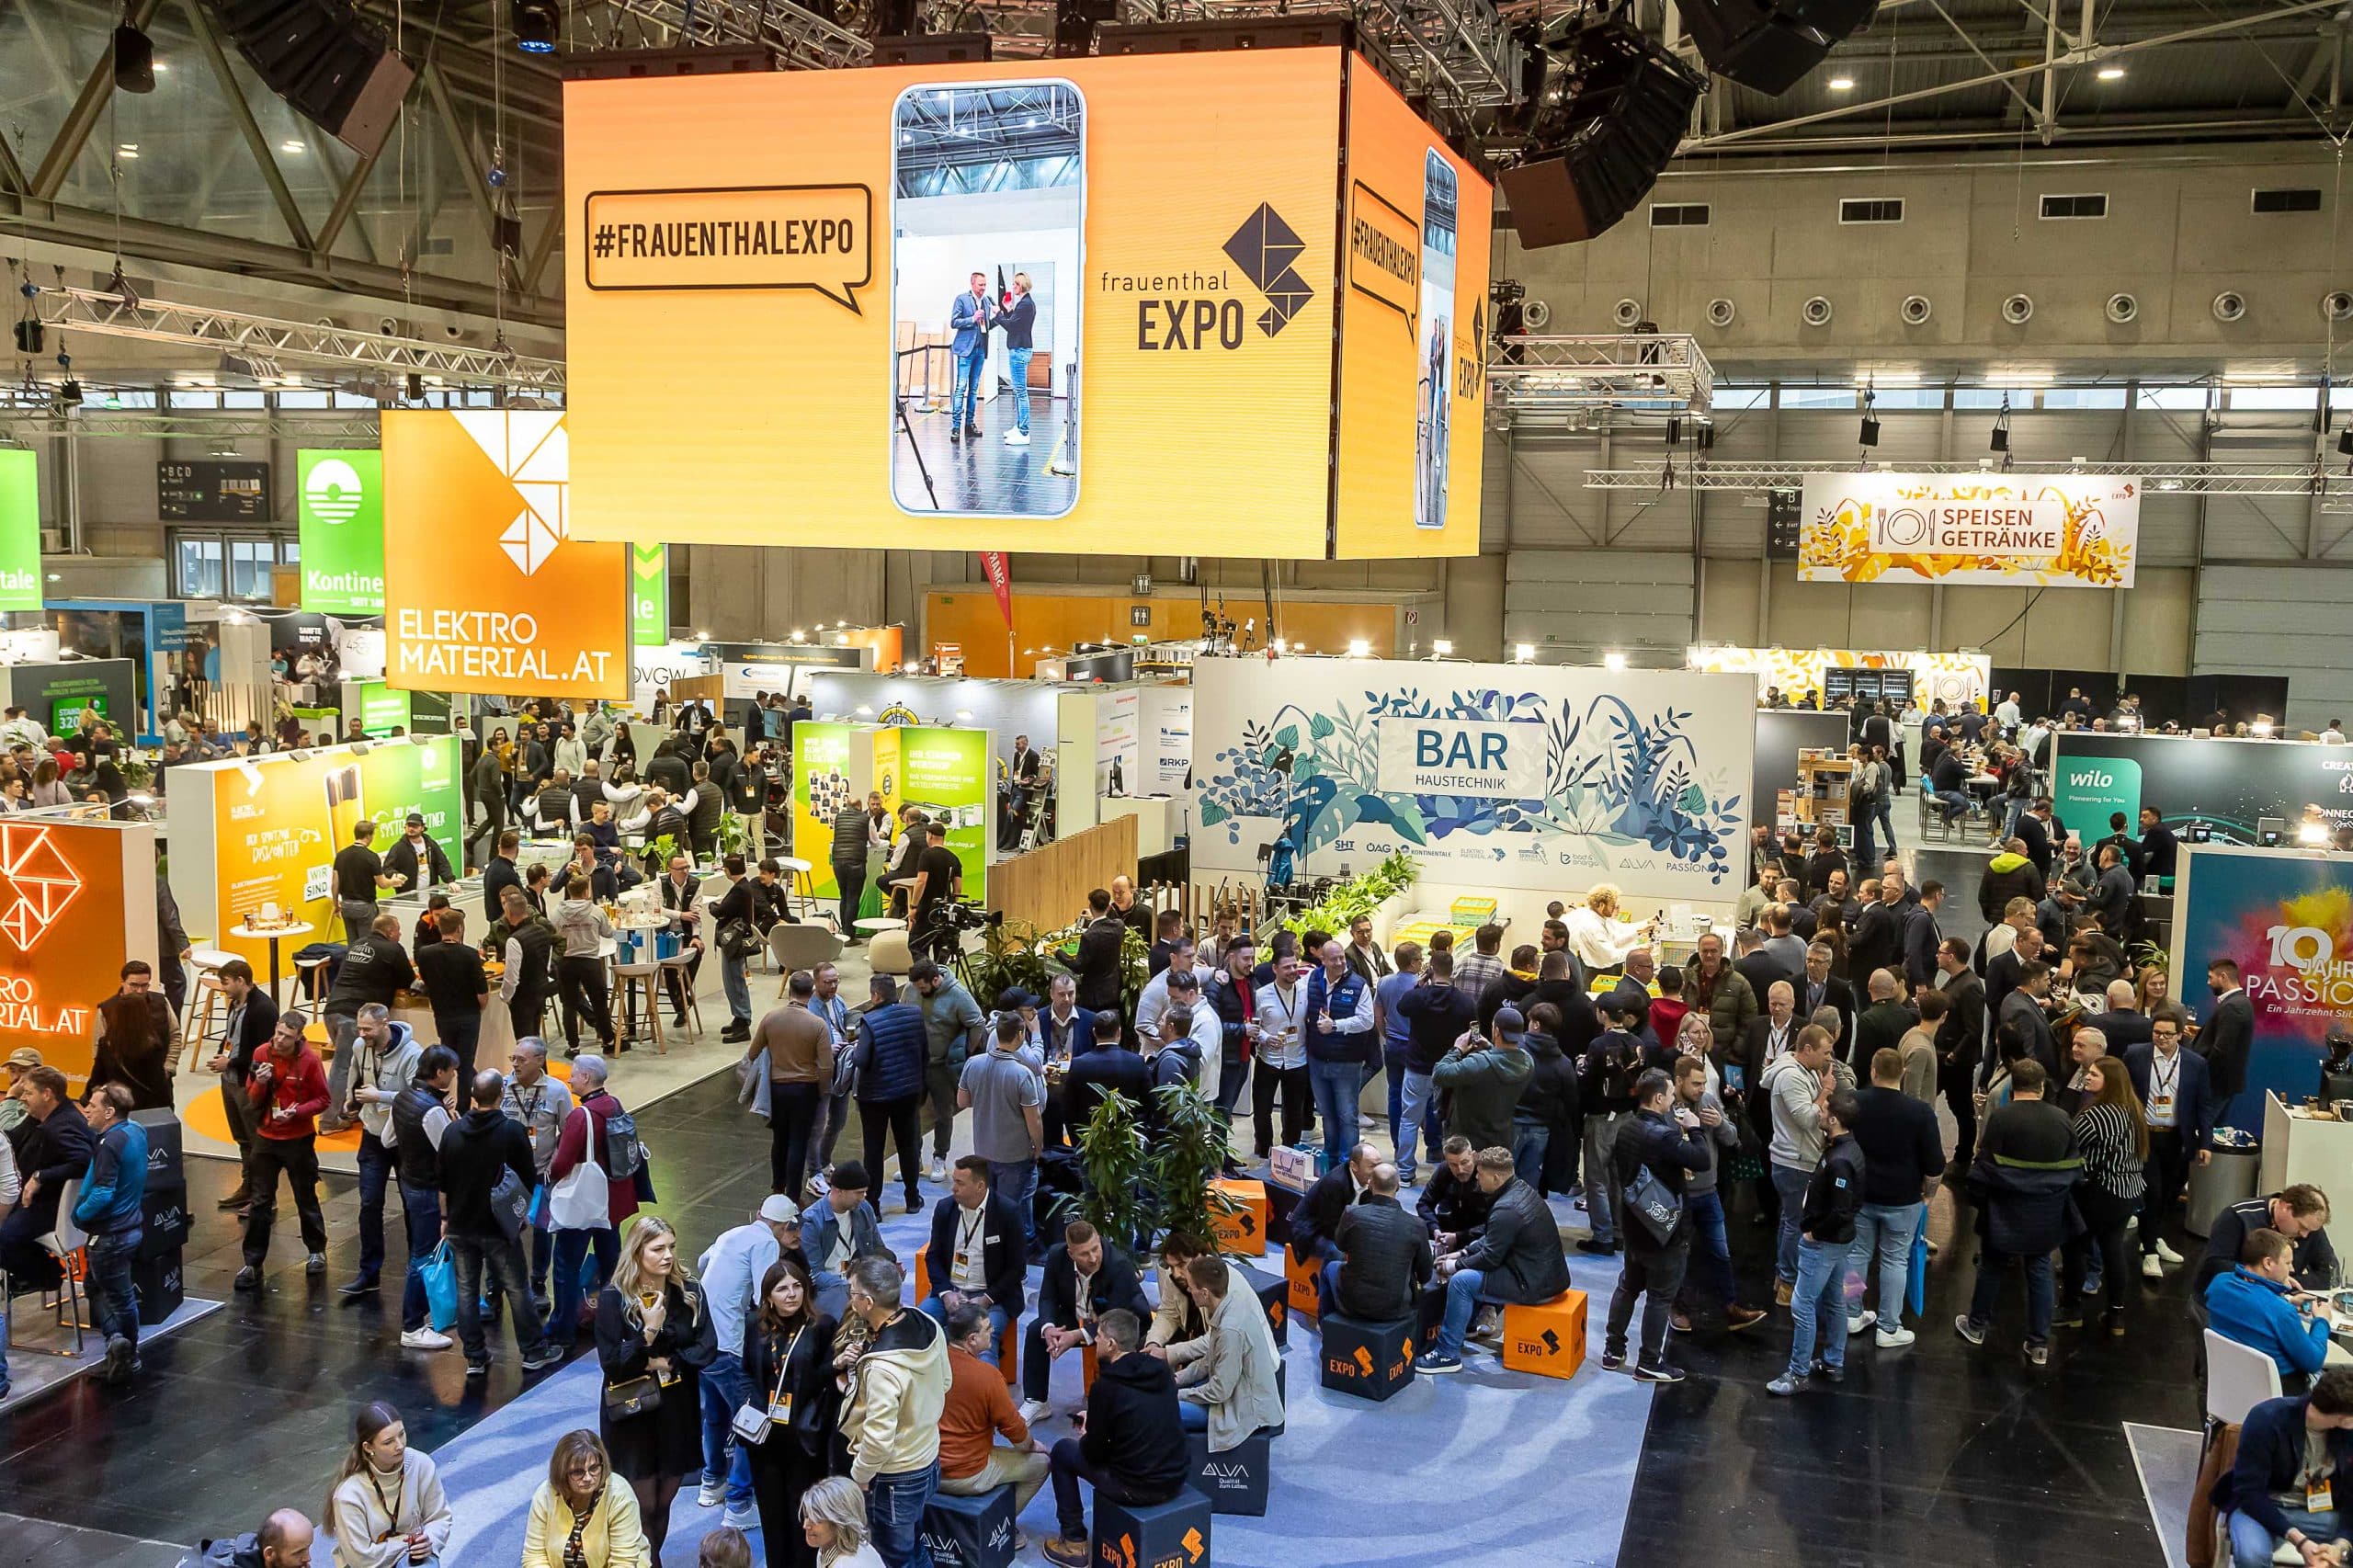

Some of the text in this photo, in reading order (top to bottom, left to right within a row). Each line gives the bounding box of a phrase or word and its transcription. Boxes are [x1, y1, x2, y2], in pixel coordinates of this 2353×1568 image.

[594, 219, 853, 258] #FRAUENTHALEXPO
[1354, 217, 1416, 287] #FRAUENTHALEXPO
[1102, 270, 1229, 292] frauenthal
[1138, 299, 1245, 351] EXPO
[1459, 357, 1475, 401] EXPO
[1788, 492, 1796, 503] B
[1943, 508, 2033, 527] SPEISEN
[1941, 528, 2056, 549] GETRÄNKE
[0, 568, 35, 590] tale
[308, 570, 382, 593] Kontine
[398, 608, 538, 644] ELEKTRO
[399, 643, 612, 683] MATERIAL.AT
[59, 716, 80, 730] 320
[1415, 729, 1509, 771] BAR
[1167, 758, 1188, 767] RKP
[1415, 773, 1506, 790] HAUSTECHNIK
[2069, 768, 2114, 789] wilo
[2068, 795, 2126, 804] Pioneering for You
[1335, 840, 1356, 849] SHT
[1411, 849, 1452, 858] KONTINENTALE
[1619, 858, 1655, 869] ALVA
[306, 881, 328, 897] SIND
[2266, 926, 2334, 969] 10
[2266, 1004, 2282, 1013] Ein
[2283, 1005, 2333, 1017] Jahrzehnt
[1218, 1229, 1241, 1240] EXPO
[1293, 1281, 1310, 1297] EXPO
[1518, 1342, 1542, 1357] EXPO
[1329, 1358, 1356, 1377] EXPO
[1389, 1360, 1404, 1381] EXPO
[1201, 1462, 1250, 1478] ALVA
[919, 1531, 963, 1555] ALVA
[1102, 1542, 1122, 1565] EXPO
[1154, 1555, 1184, 1568] EXPO
